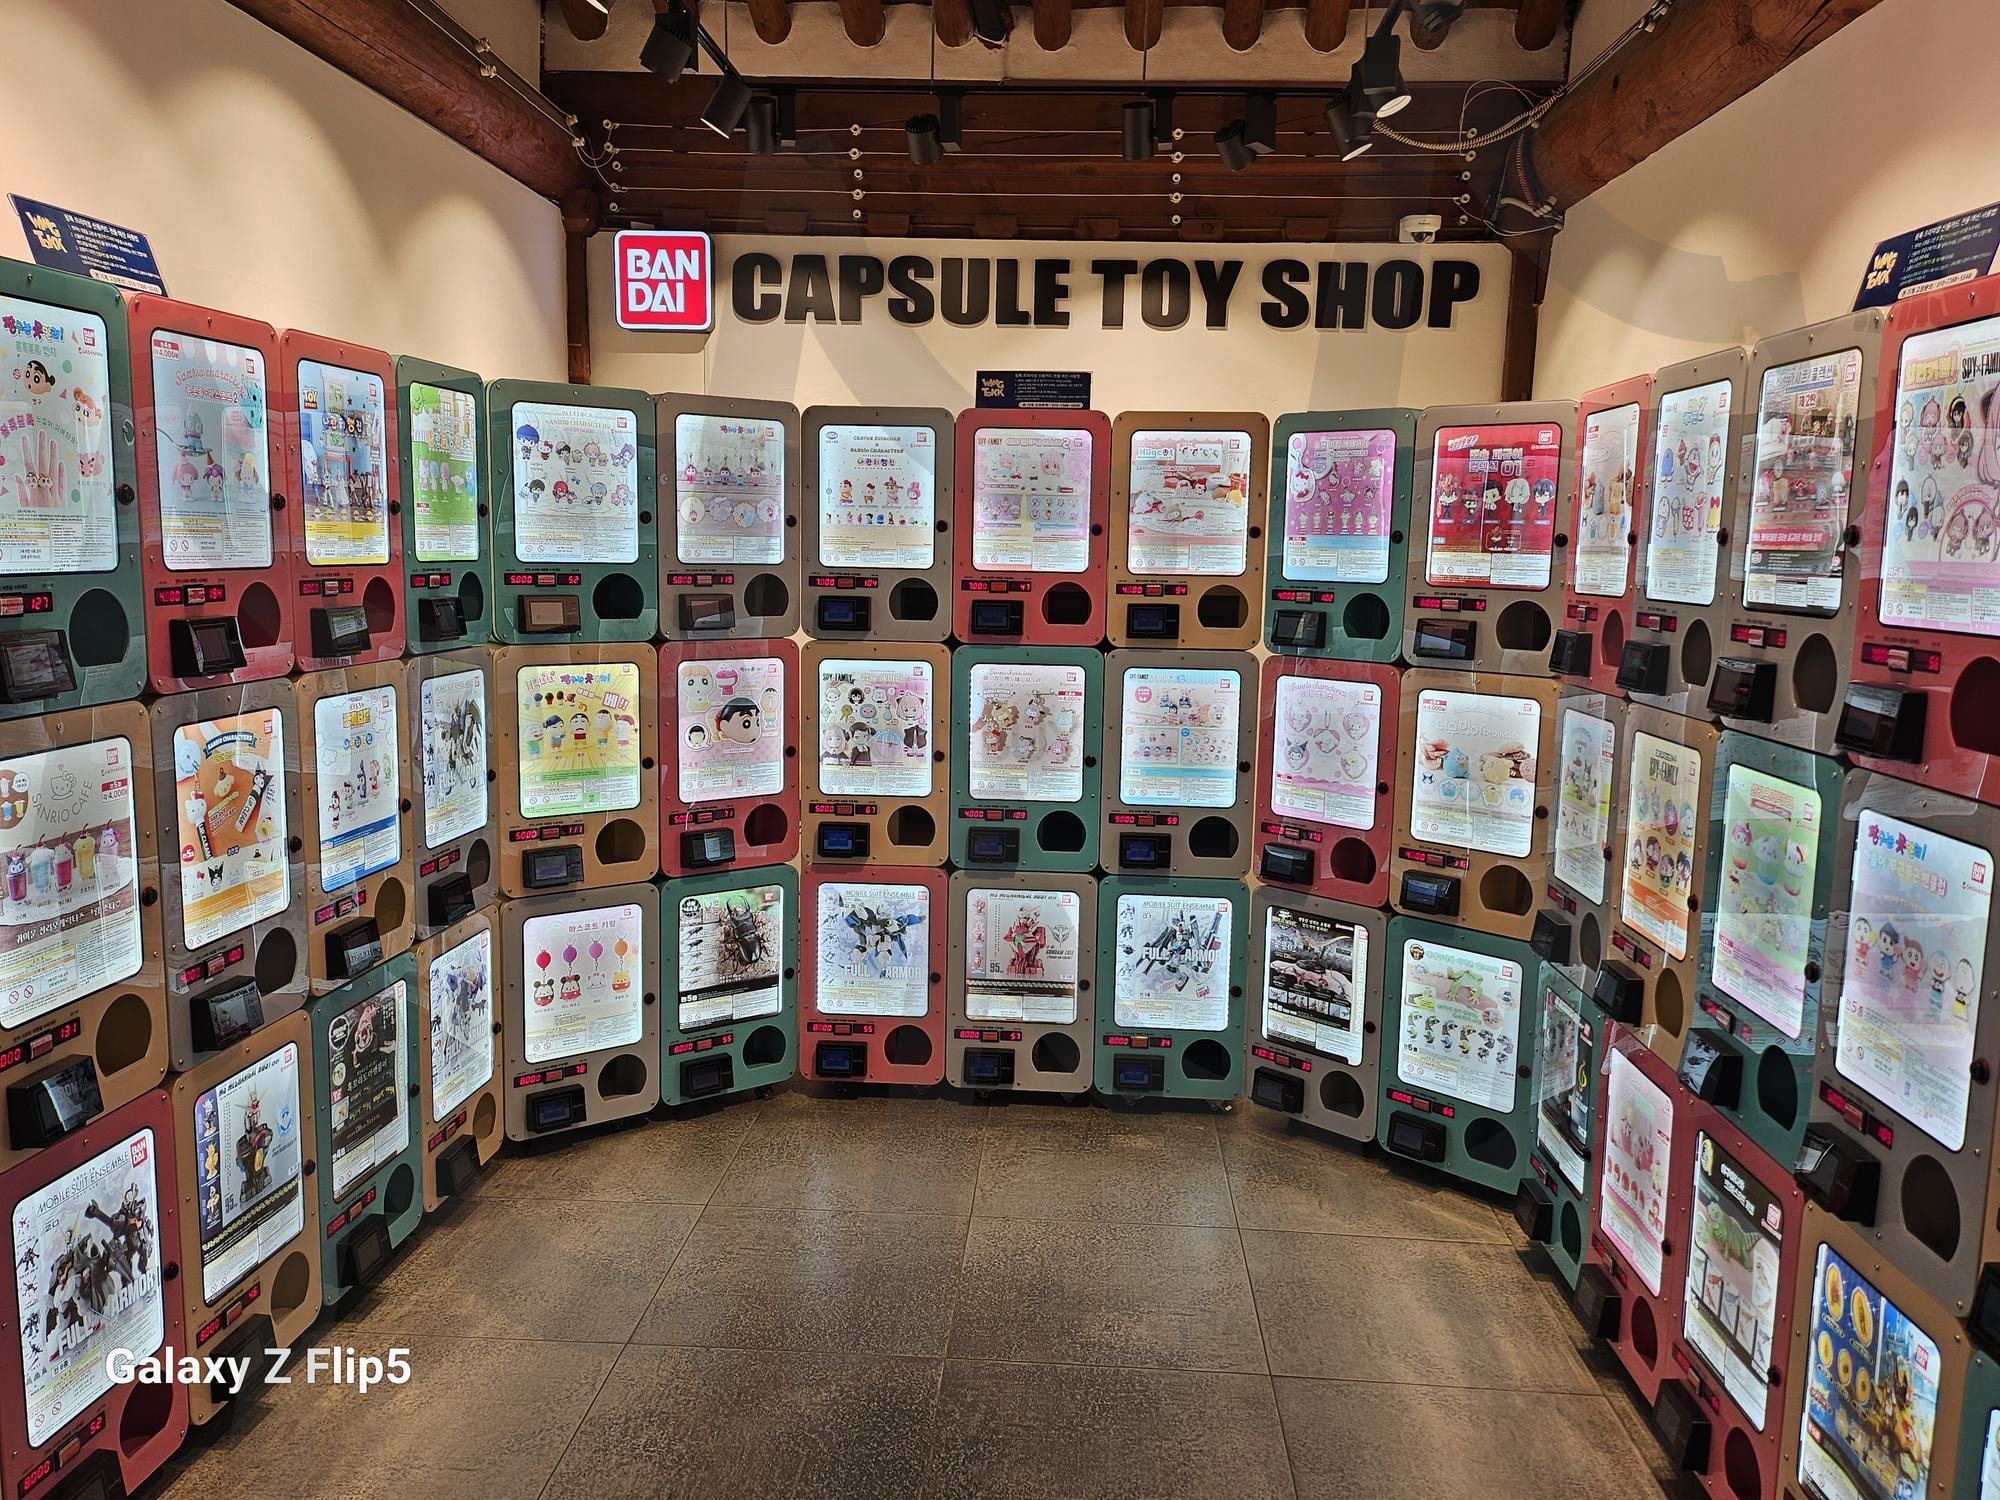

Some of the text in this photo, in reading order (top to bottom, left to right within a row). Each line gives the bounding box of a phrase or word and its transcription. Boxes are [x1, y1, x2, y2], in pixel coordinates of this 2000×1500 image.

[627, 249, 700, 280] BAN
[627, 281, 684, 314] DAI
[731, 252, 1481, 330] CAPSULE TOY SHOP
[303, 388, 318, 403] TOY
[1501, 461, 1522, 476] 01
[32, 780, 94, 823] SANRIO CAFE
[569, 920, 616, 933] 마스코트 키링
[885, 965, 922, 979] ARMOR
[989, 962, 1000, 973] 95
[61, 1023, 77, 1039] 131
[37, 1188, 71, 1215] MOBILE
[90, 1151, 130, 1185] ENSEMBLE
[59, 1315, 94, 1358] FULL
[90, 1417, 103, 1434] 52
[22, 1464, 51, 1491] 8000
